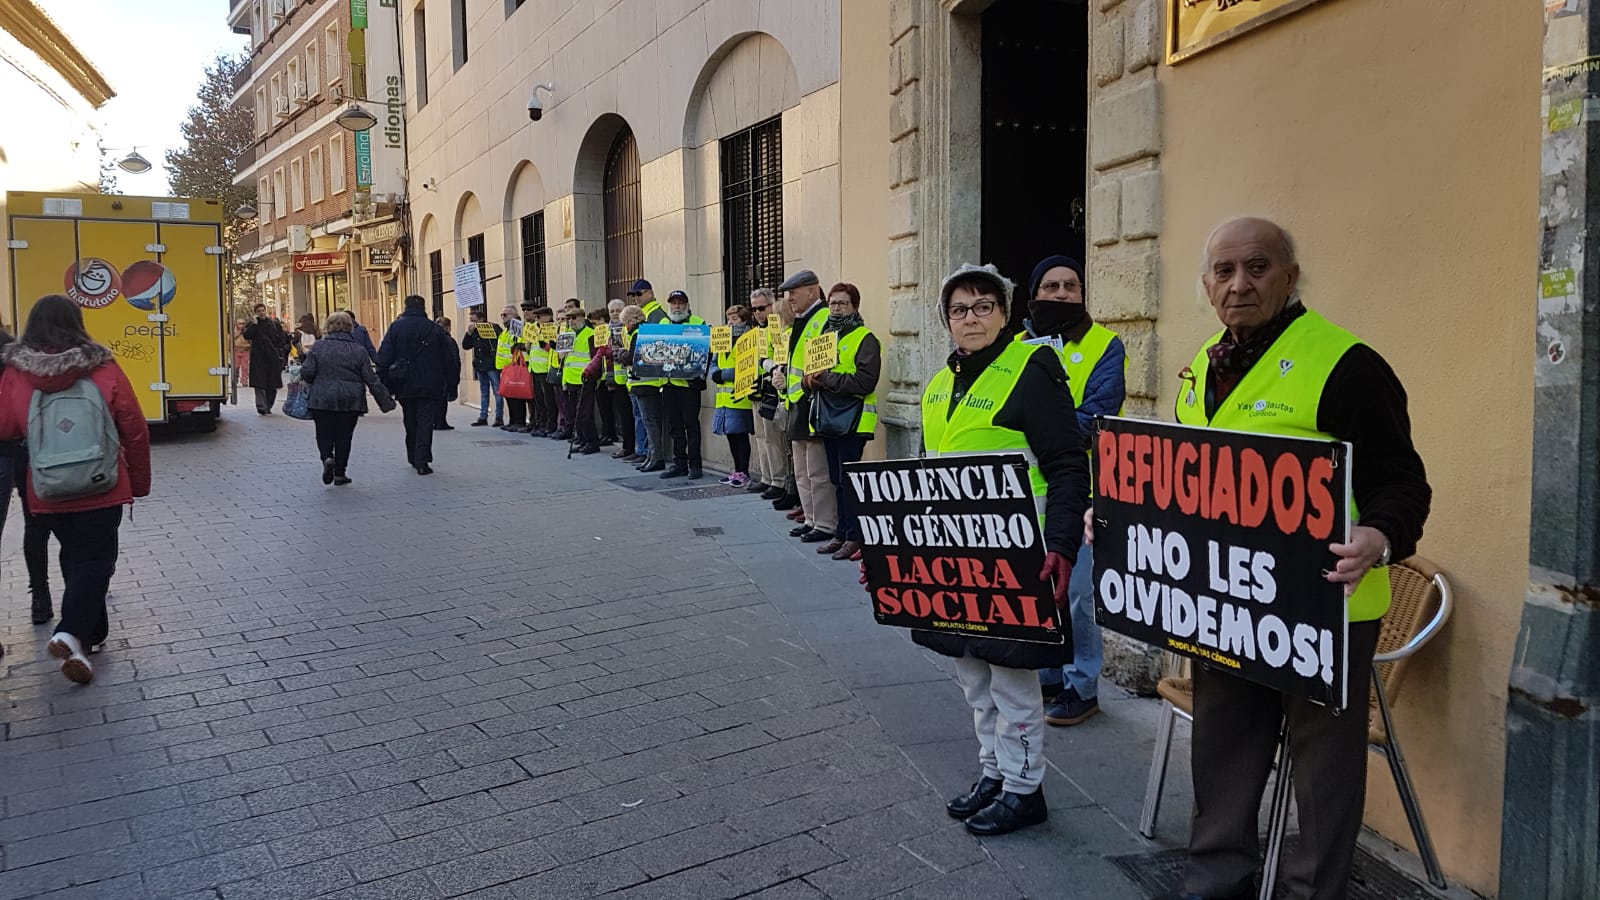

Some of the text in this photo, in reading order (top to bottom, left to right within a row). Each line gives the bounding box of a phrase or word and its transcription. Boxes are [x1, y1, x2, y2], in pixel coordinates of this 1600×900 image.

[385, 75, 401, 149] idiomas
[1550, 271, 1567, 282] VOTA
[68, 286, 119, 307] matutano
[124, 323, 177, 339] pepsi
[807, 342, 833, 356] MALTRATO
[811, 335, 830, 346] PRIMER
[811, 352, 828, 362] LARGA
[850, 464, 1026, 503] VIOLENCIA
[1098, 430, 1335, 540] REFUGIADOS
[857, 506, 1035, 549] DE GÉNERO
[885, 554, 1023, 590] LACRA
[1127, 523, 1277, 604] ¡NO LES
[876, 587, 1054, 629] SOCIAL
[1100, 568, 1334, 684] OLVIDEMOS!
